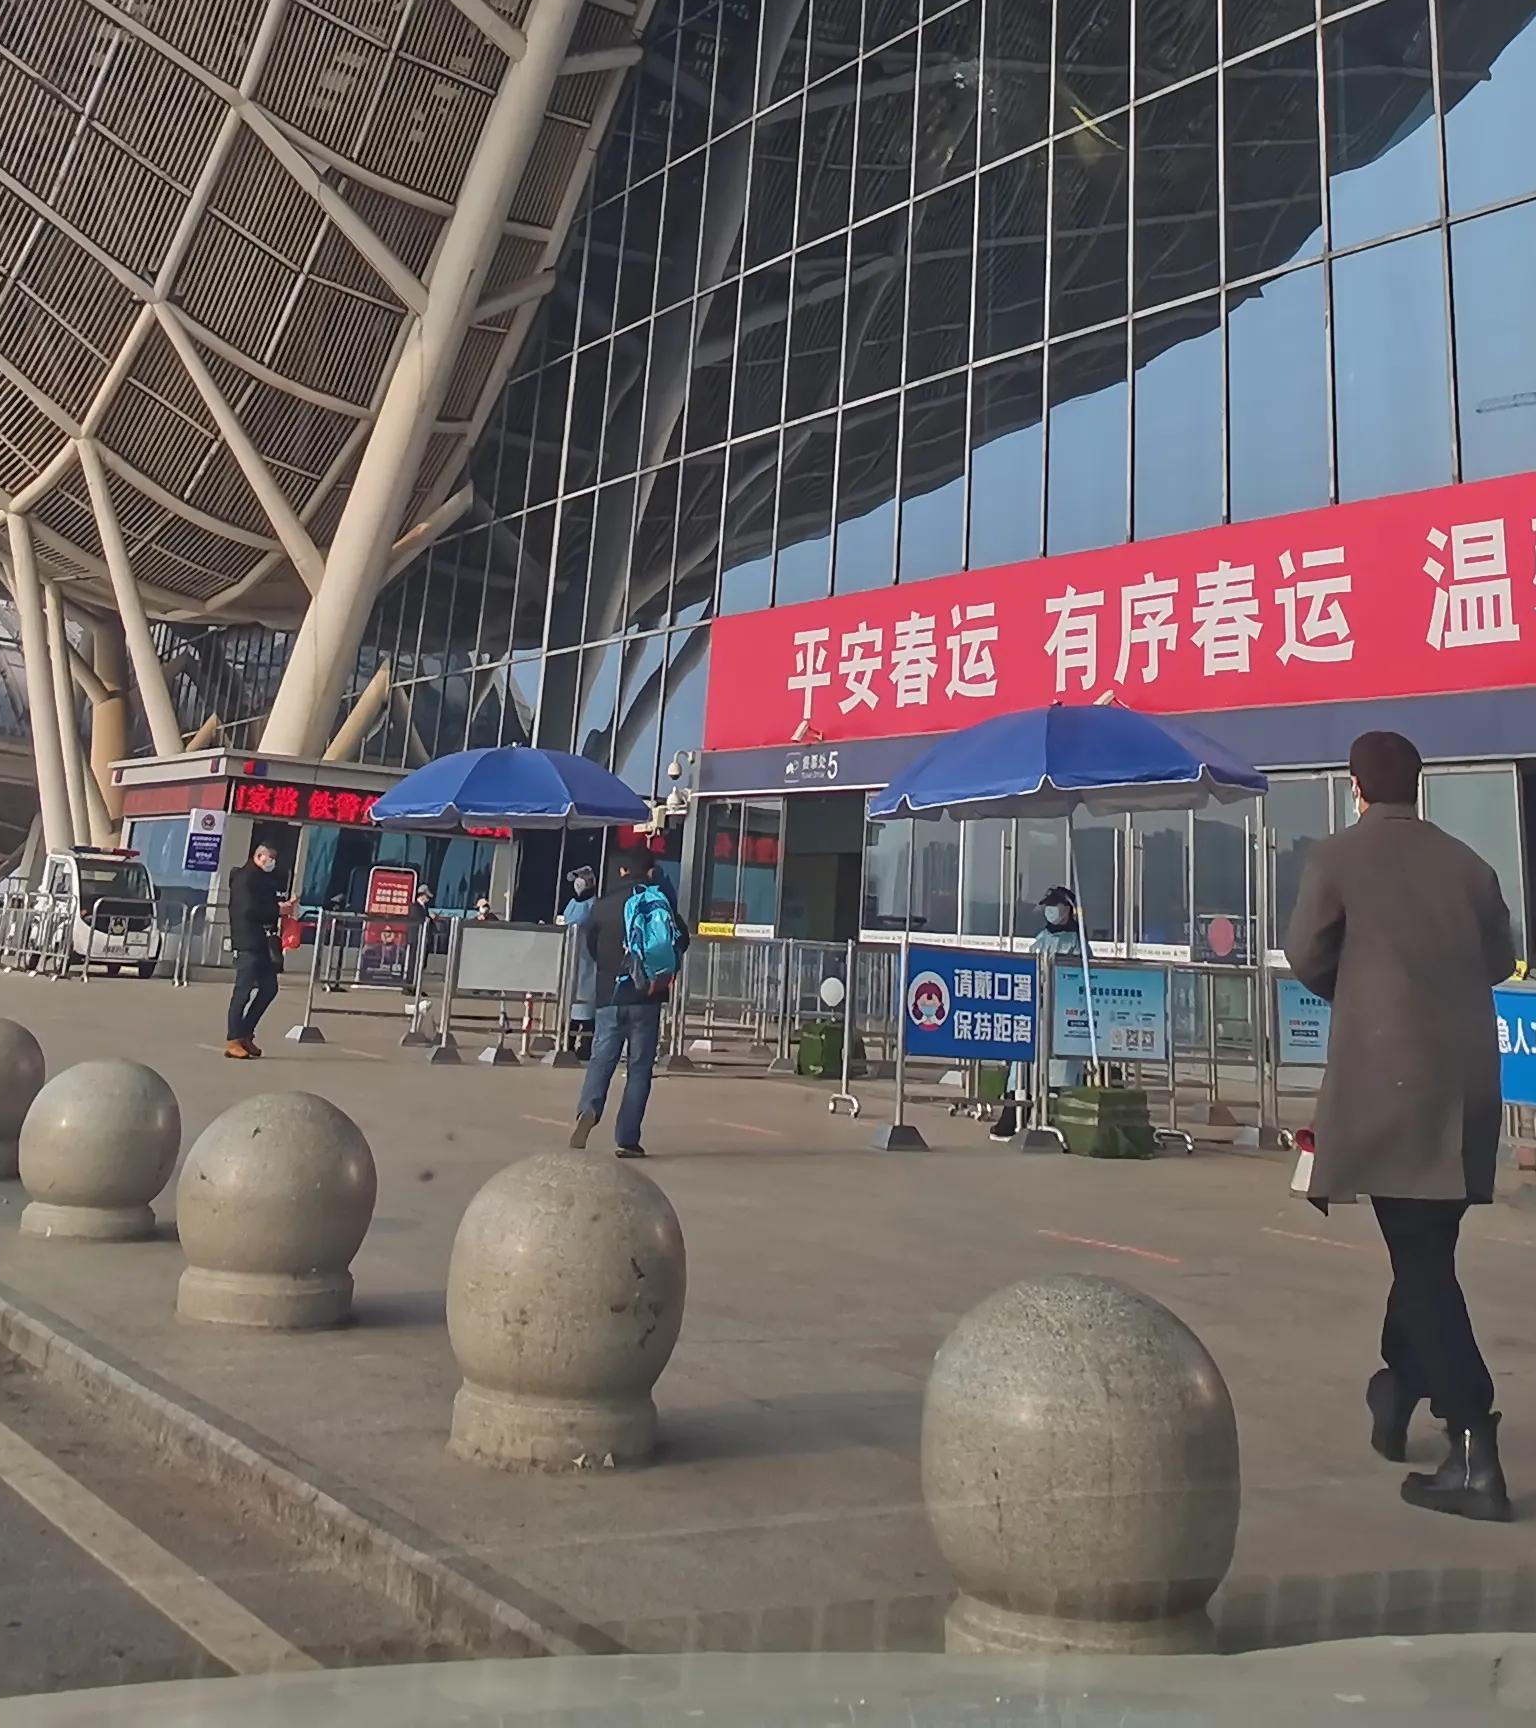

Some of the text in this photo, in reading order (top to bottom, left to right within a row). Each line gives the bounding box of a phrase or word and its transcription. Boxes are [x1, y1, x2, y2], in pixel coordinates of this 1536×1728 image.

[786, 601, 999, 722] 平安春运
[1044, 545, 1356, 692] 有序春运
[827, 750, 839, 780] 5
[954, 968, 1032, 1002] 请戴口罩
[953, 1009, 1032, 1044] 保持距离
